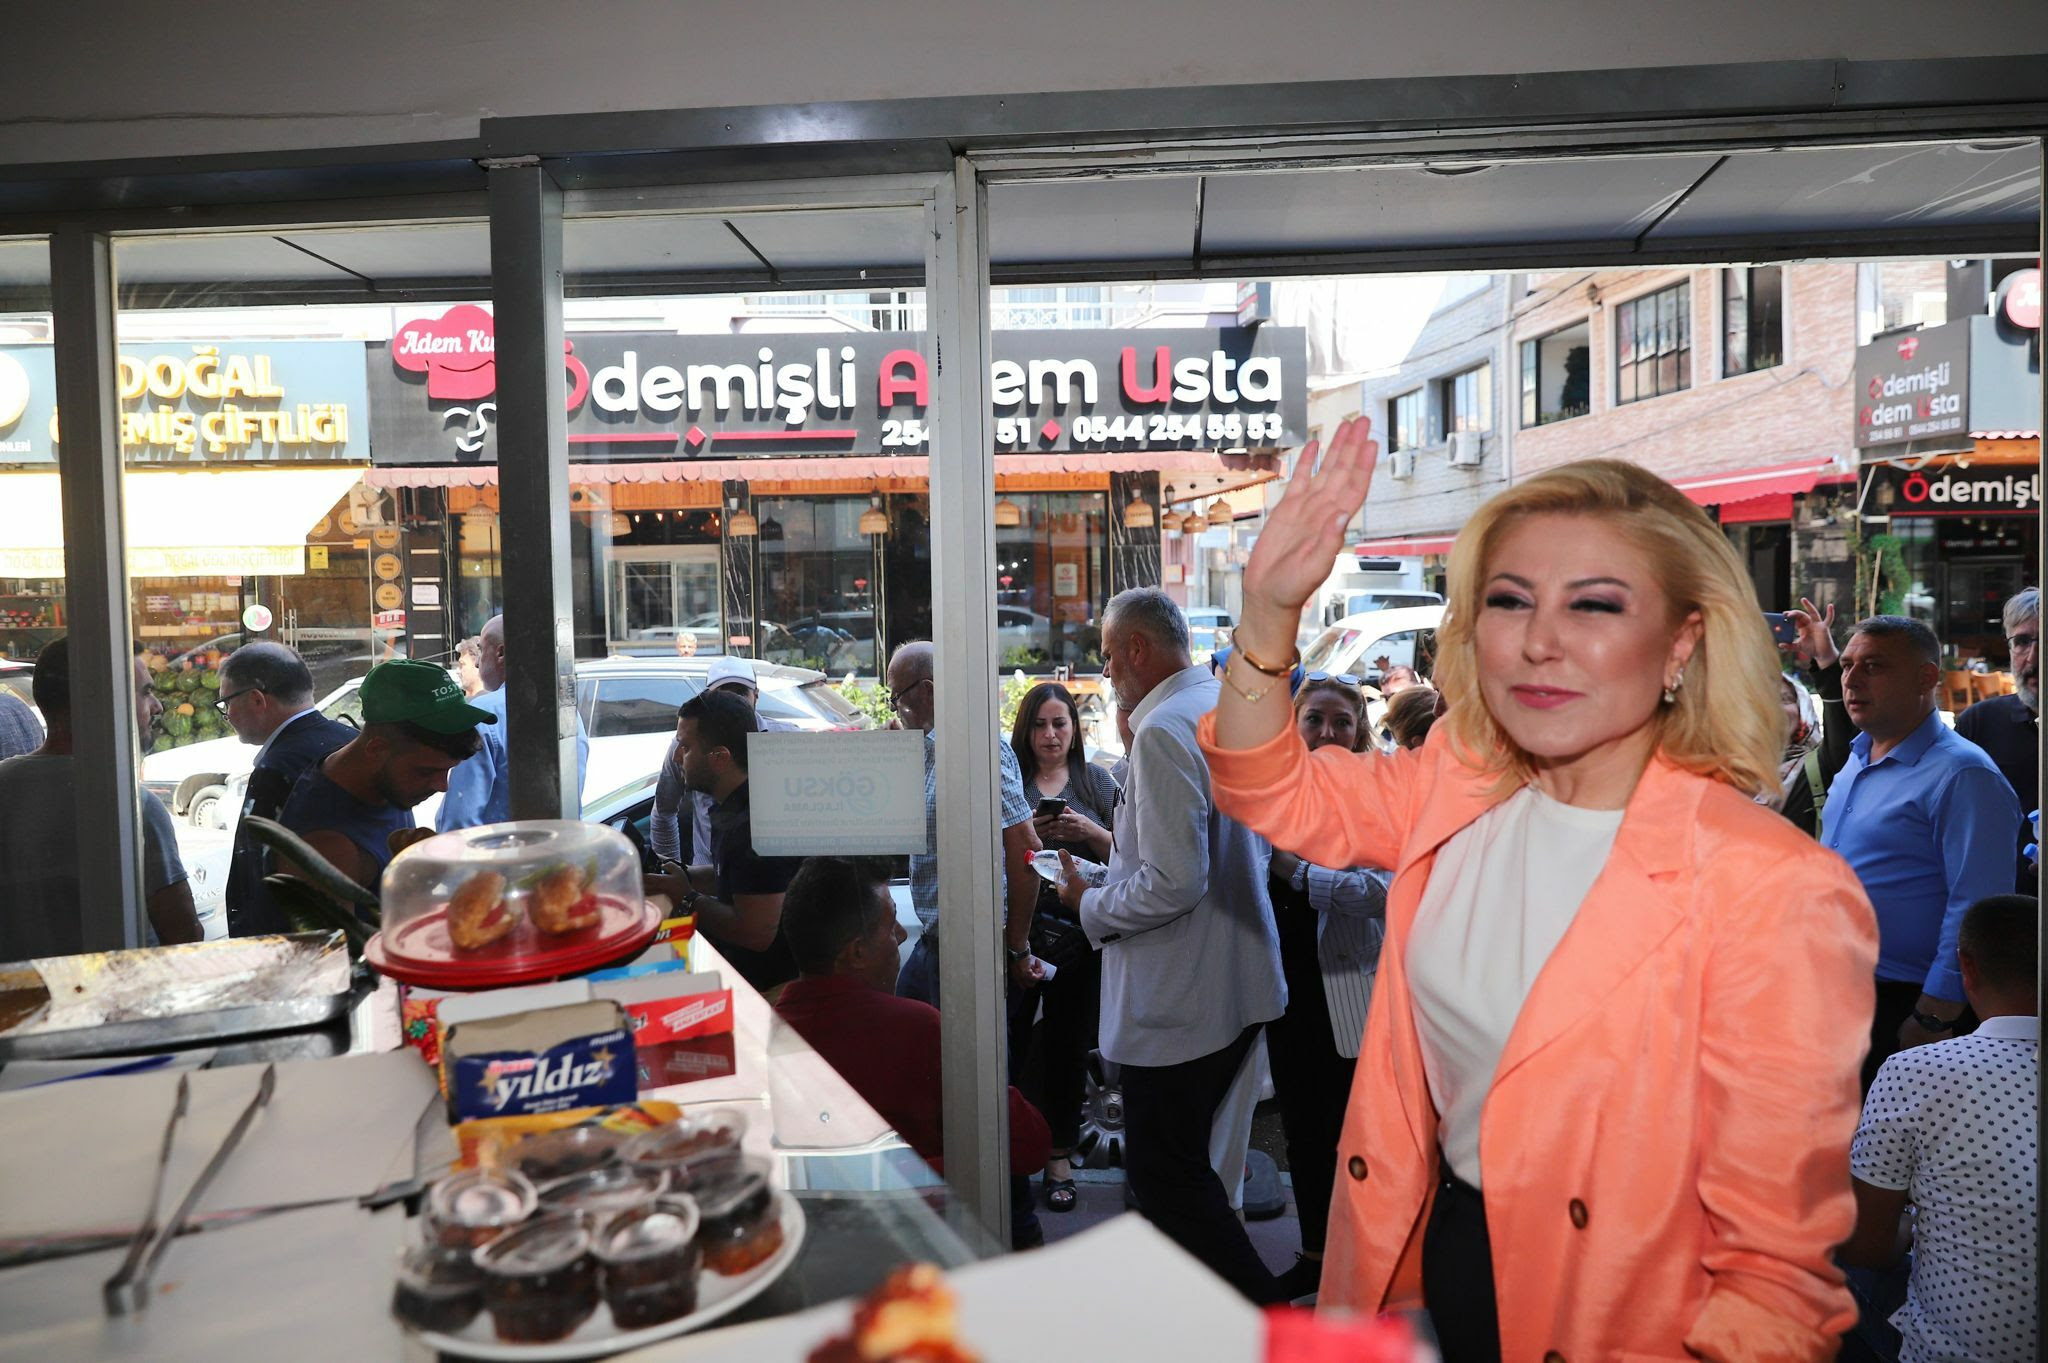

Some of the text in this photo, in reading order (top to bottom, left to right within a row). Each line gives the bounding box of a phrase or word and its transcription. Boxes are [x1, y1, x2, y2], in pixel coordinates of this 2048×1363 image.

[400, 329, 463, 354] Adem
[118, 345, 285, 399] DOĞAL
[879, 348, 1098, 408] Aem
[1121, 345, 1282, 404] Usta
[1869, 362, 1950, 401] Ödemişli
[1917, 393, 1960, 417] Usta
[200, 403, 348, 453] ÇİFTLİĞİ
[1072, 415, 1147, 443] 0544
[1149, 414, 1203, 441] 254
[1206, 413, 1243, 440] 55
[1246, 412, 1283, 439] 53
[493, 1053, 605, 1110] yıldız
